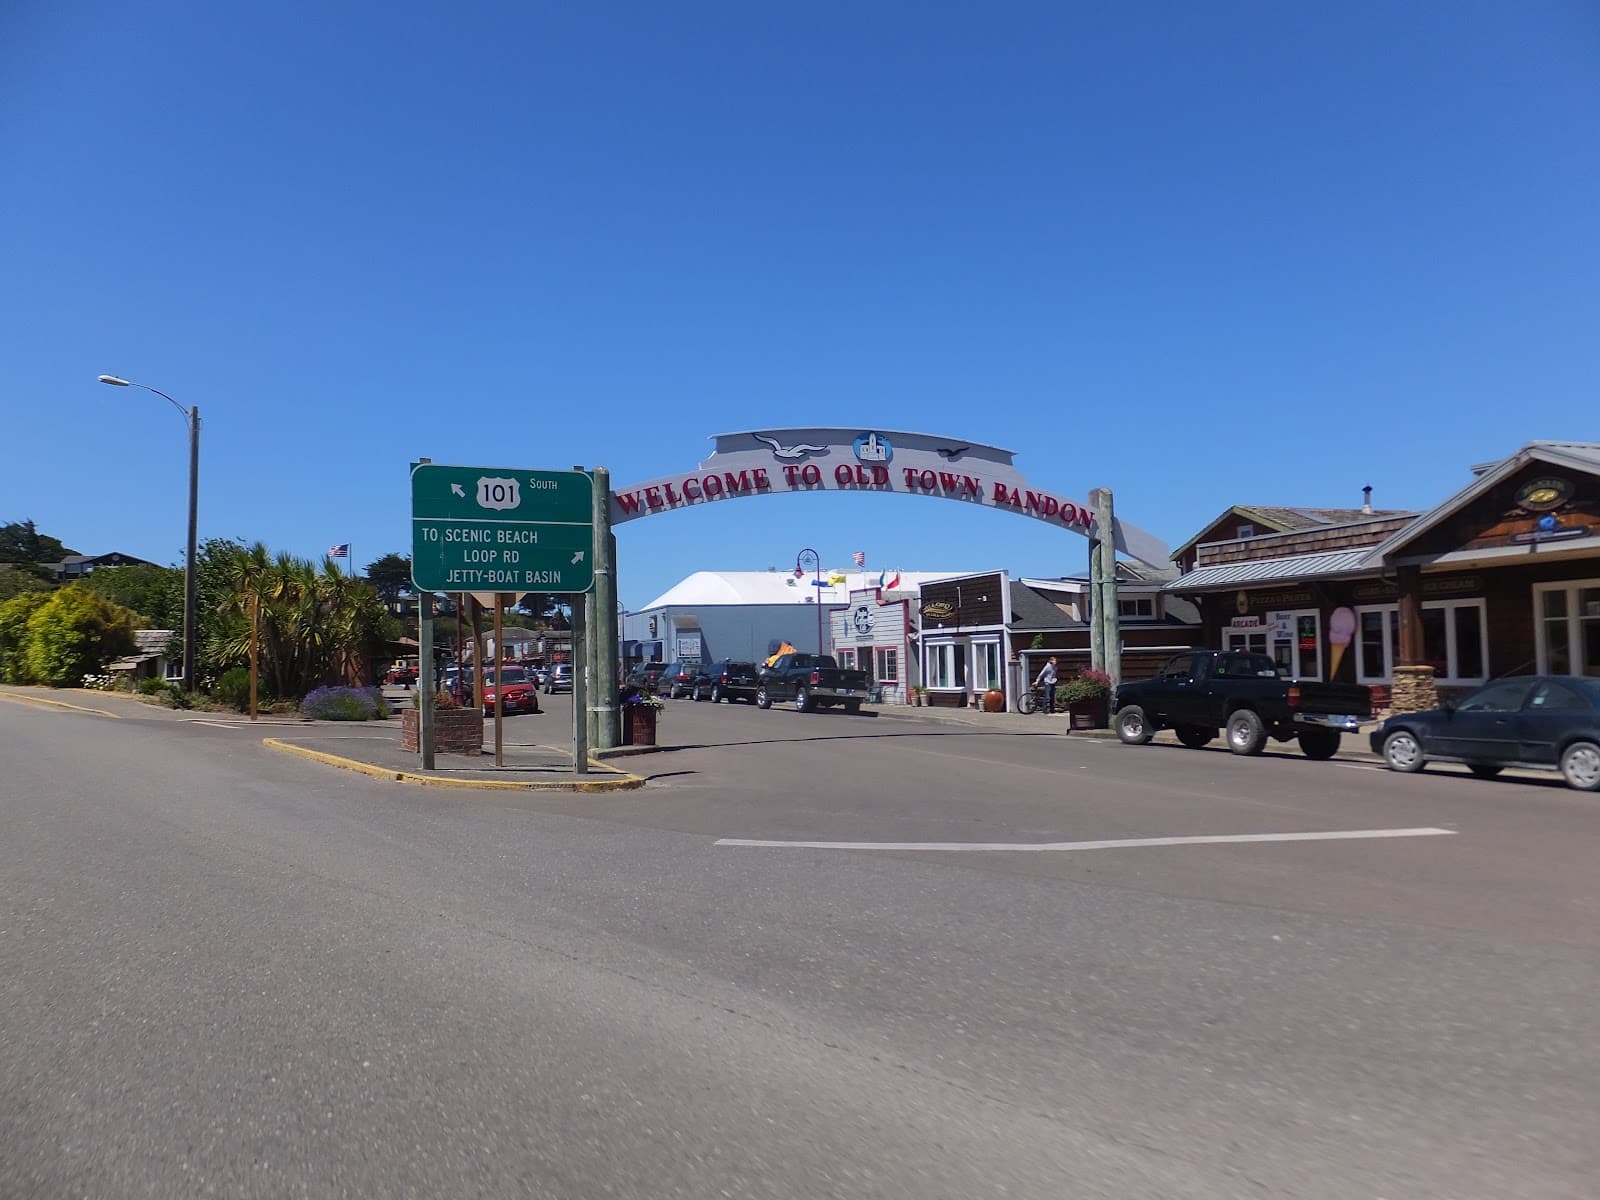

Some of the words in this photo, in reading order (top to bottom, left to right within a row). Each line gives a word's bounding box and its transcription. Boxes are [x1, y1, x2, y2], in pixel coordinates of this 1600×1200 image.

[483, 484, 514, 503] 101
[529, 478, 558, 490] SOUTH
[616, 468, 770, 515] WELCOME
[783, 464, 821, 487] TO
[834, 464, 889, 486] OLD
[903, 467, 980, 497] TOWN
[992, 482, 1096, 529] BANDON
[422, 527, 438, 542] TO
[445, 529, 491, 543] SCENIC
[497, 531, 538, 544] BEACH
[463, 550, 497, 563] LOOP
[503, 550, 519, 563] RD
[446, 569, 519, 583] JETTY-BOAT
[525, 570, 561, 584] BASIN
